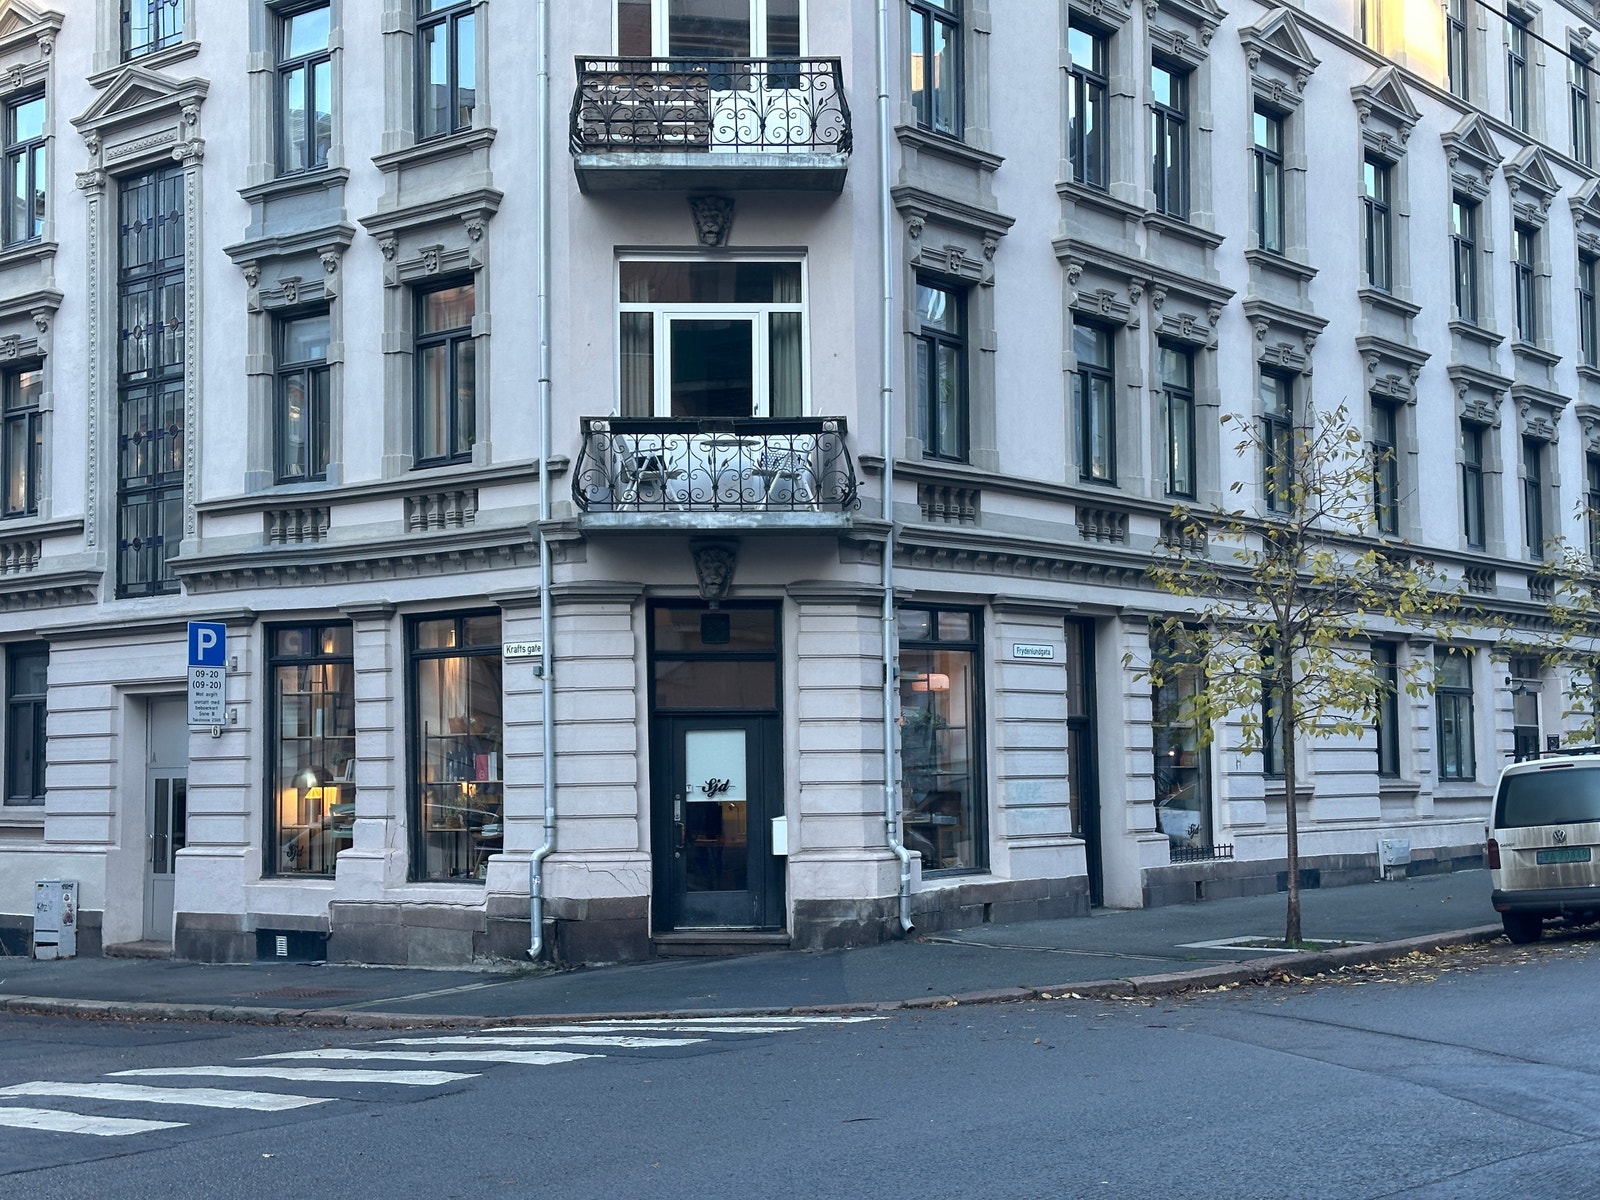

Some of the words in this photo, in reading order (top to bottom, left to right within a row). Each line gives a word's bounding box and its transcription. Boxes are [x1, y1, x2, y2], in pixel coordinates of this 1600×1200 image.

[198, 628, 217, 661] P
[506, 644, 526, 654] Krafts
[527, 644, 541, 654] gate
[1016, 646, 1050, 656] Frydenlundgata
[195, 670, 219, 678] 09-20
[192, 680, 222, 690] (09-20)
[212, 725, 218, 737] 6
[702, 777, 729, 797] Sjd
